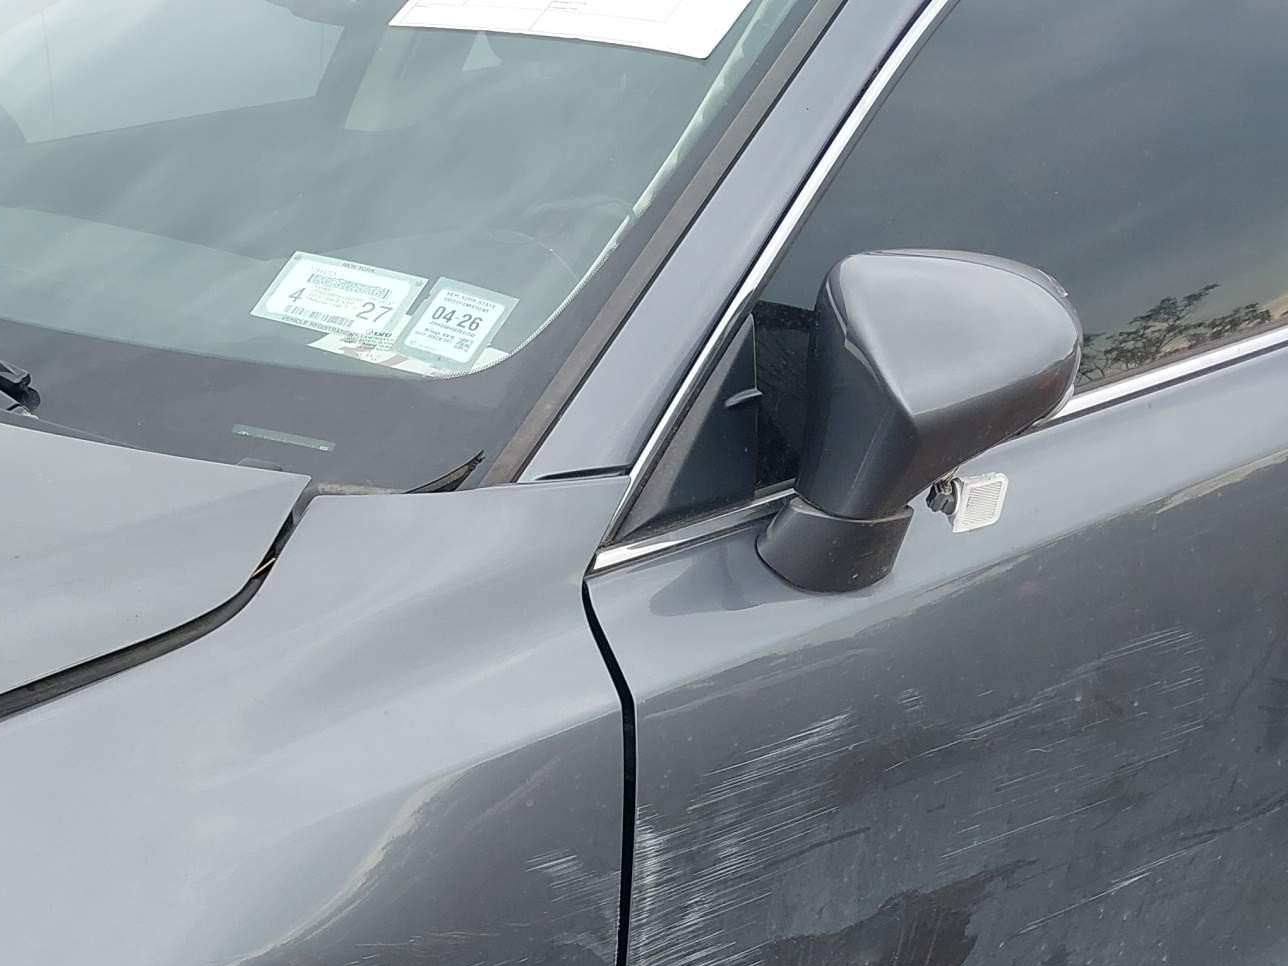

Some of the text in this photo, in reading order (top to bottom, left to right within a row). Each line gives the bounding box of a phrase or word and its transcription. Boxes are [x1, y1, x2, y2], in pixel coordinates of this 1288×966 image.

[288, 287, 306, 303] 4
[355, 301, 393, 323] 27
[431, 305, 484, 332] 04-26
